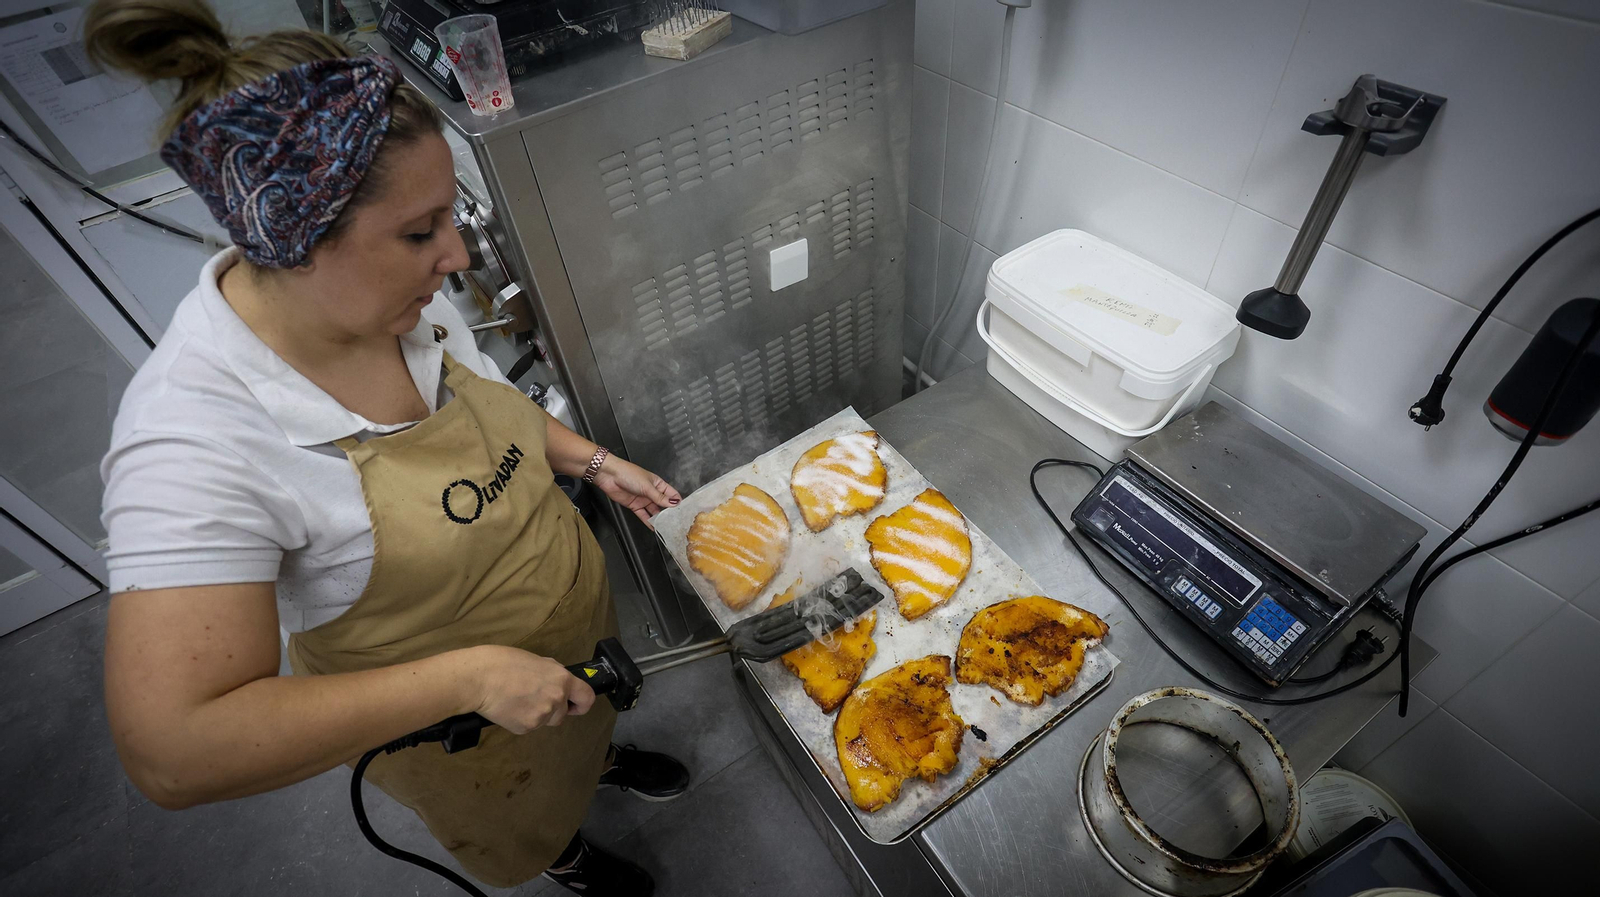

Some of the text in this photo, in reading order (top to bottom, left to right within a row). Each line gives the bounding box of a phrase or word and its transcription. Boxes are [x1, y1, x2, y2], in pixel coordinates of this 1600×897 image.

[1215, 550, 1246, 574] PRECIO TOTAL
[1270, 645, 1281, 655] ZERO
